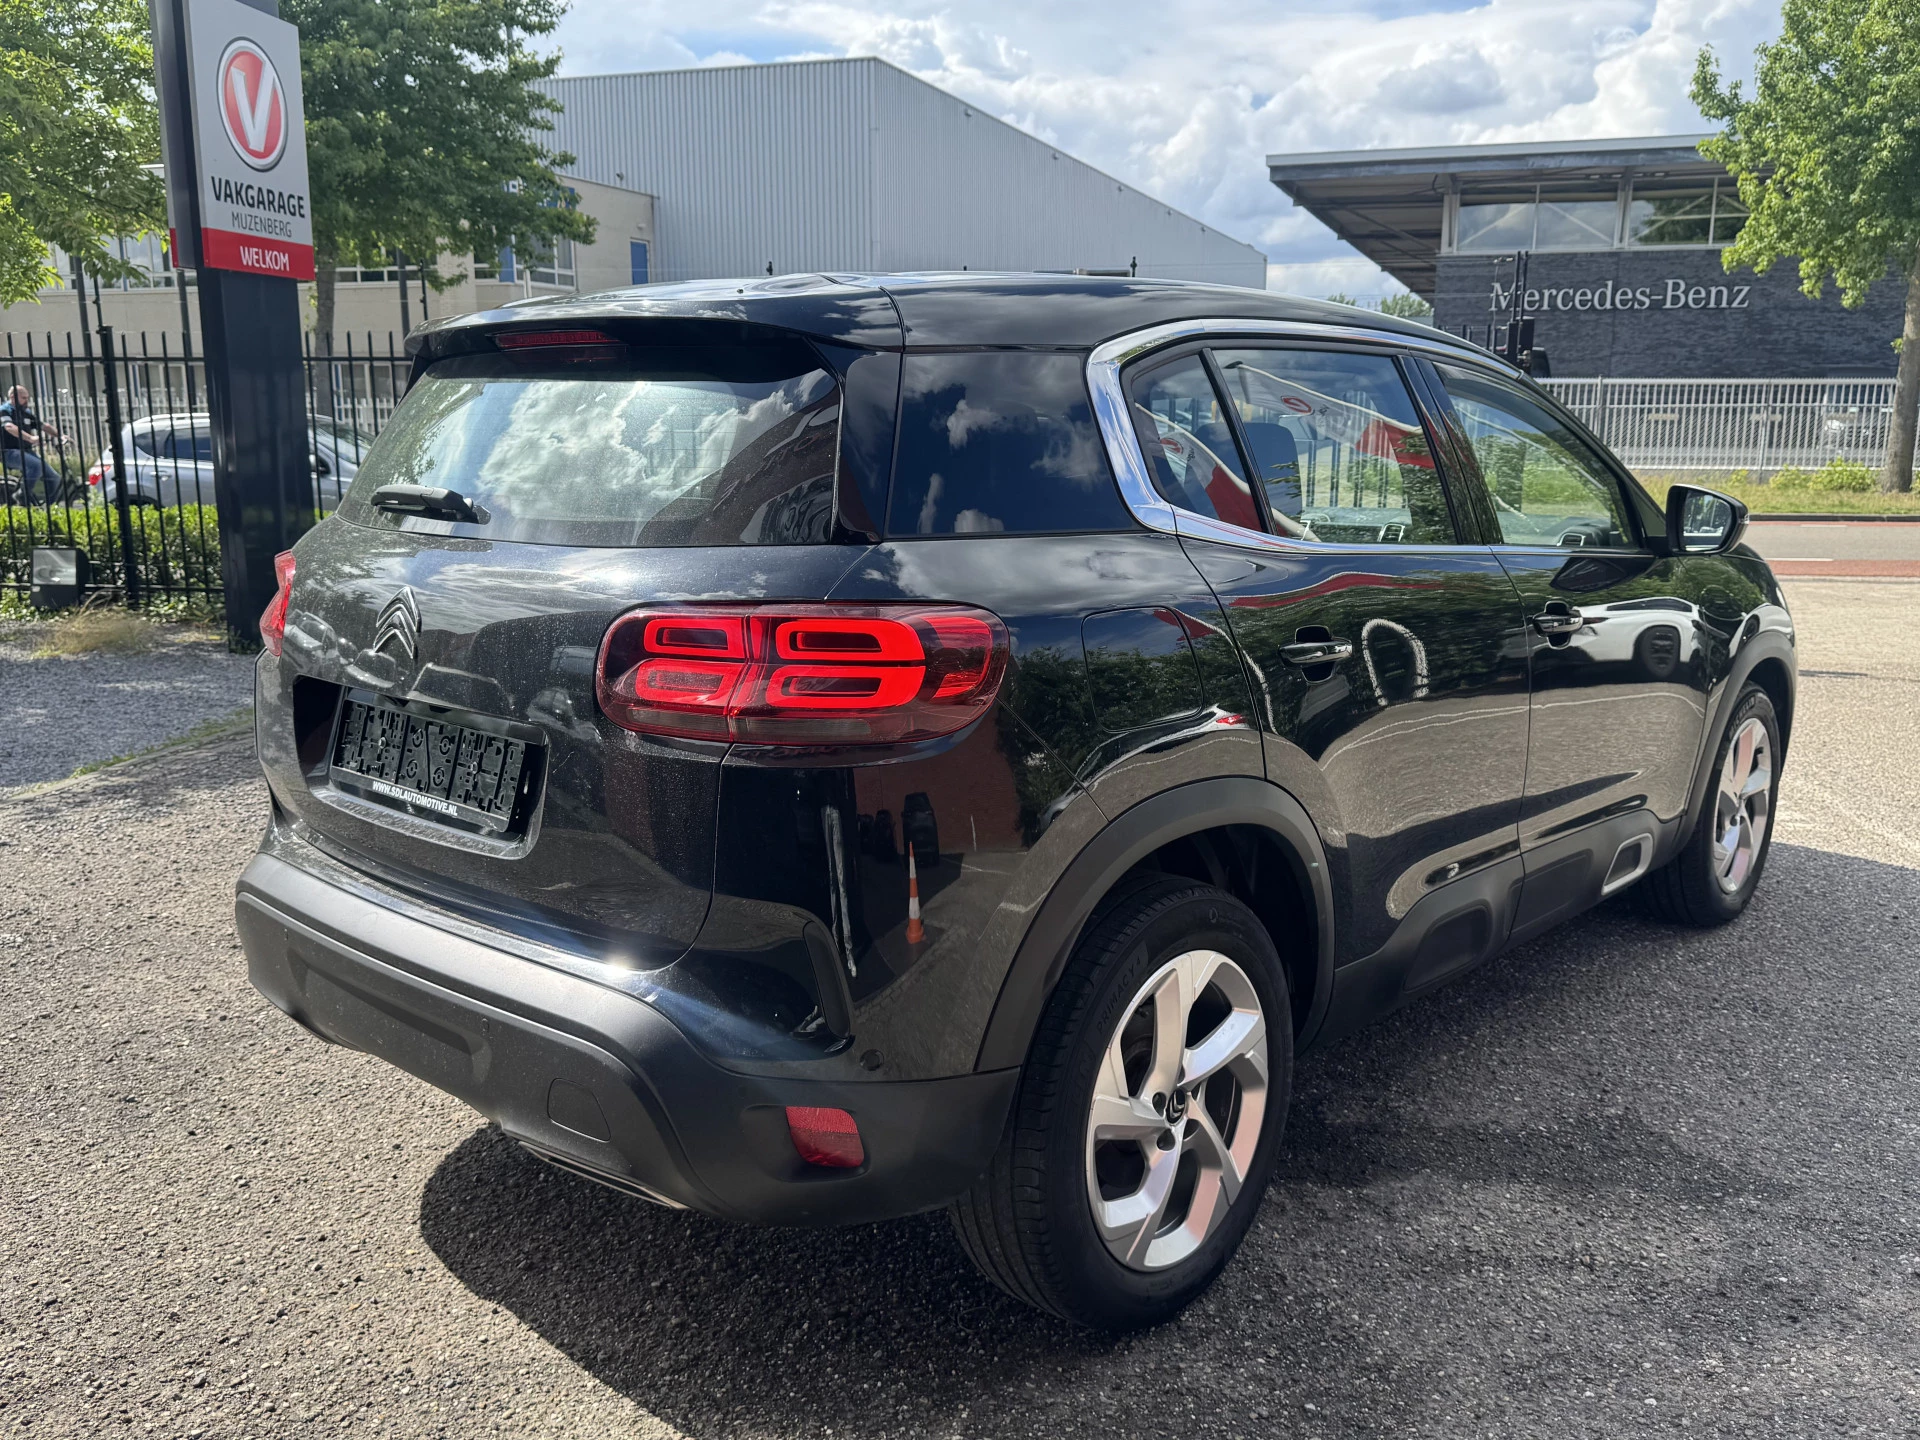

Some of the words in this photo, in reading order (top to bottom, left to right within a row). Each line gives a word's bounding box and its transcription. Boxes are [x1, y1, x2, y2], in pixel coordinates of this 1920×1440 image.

[211, 176, 305, 218] VAKGARAGE
[231, 211, 292, 237] MUZENBERG
[240, 246, 290, 272] WELKOM
[1488, 279, 1751, 311] Mercedes-Benz
[1096, 963, 1136, 1034] PRIMACY
